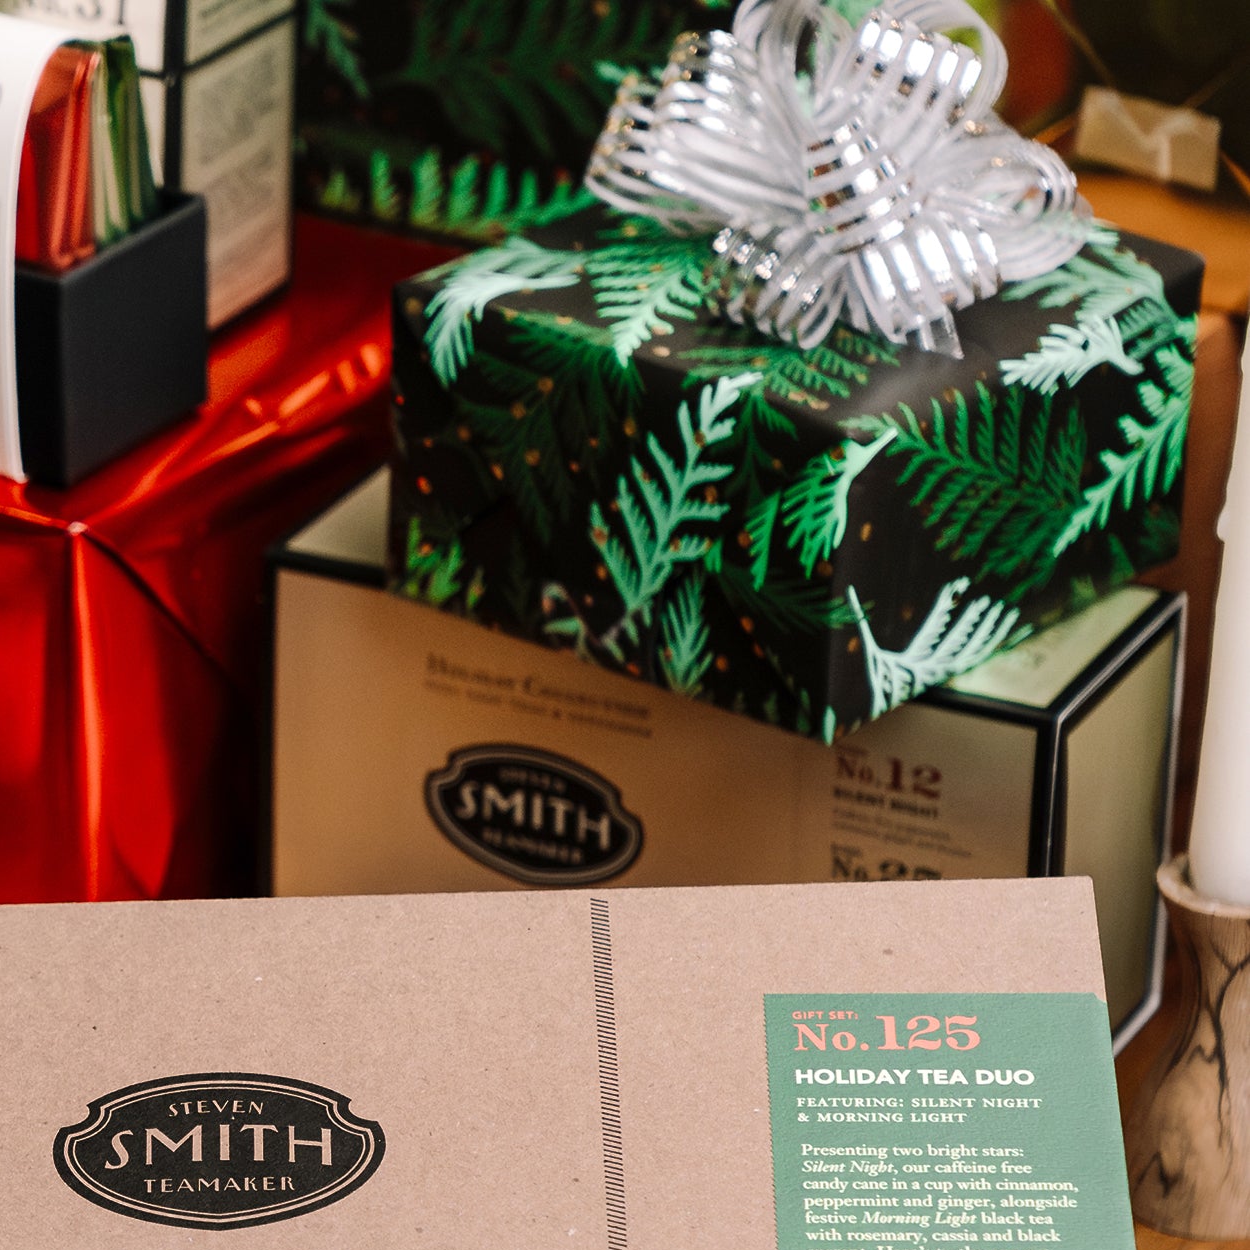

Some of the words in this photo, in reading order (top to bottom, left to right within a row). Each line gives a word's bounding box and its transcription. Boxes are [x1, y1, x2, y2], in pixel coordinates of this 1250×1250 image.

[886, 757, 942, 798] 12
[455, 781, 610, 850] SMITH
[792, 1011, 824, 1020] GIFT
[828, 1011, 859, 1020] SET:
[793, 1023, 870, 1051] No.
[876, 1015, 981, 1051] 125
[795, 1069, 911, 1085] HOLIDAY
[917, 1069, 969, 1085] TEA
[975, 1069, 1036, 1086] DUO
[168, 1100, 264, 1117] STEVEN
[797, 1097, 904, 1108] FEATURING:
[911, 1097, 976, 1108] SILENT
[982, 1097, 1043, 1109] NIGHT
[797, 1113, 810, 1123] &
[817, 1112, 903, 1123] MORNING
[910, 1112, 968, 1123] LIGHT
[104, 1124, 333, 1170] SMITH
[801, 1143, 888, 1160] Presenting
[893, 1146, 923, 1157] two
[927, 1144, 978, 1160] bright
[982, 1146, 1024, 1157] stars:
[802, 1160, 846, 1173] Silent
[849, 1160, 899, 1177] Night,
[902, 1164, 931, 1173] our
[934, 1161, 997, 1174] caffeine
[1001, 1161, 1033, 1174] free
[143, 1176, 295, 1194] TEAMAKER
[802, 1177, 849, 1193] candy
[852, 1180, 888, 1190] cane
[892, 1178, 908, 1190] in
[911, 1181, 920, 1190] a
[924, 1181, 953, 1193] cup
[956, 1178, 992, 1191] with
[995, 1178, 1079, 1193] cinnamon,
[804, 1195, 899, 1210] peppermint
[903, 1194, 933, 1207] and
[937, 1195, 996, 1211] ginger,
[1000, 1195, 1078, 1211] alongside
[805, 1210, 857, 1224] festive
[862, 1211, 931, 1228] Morning
[935, 1211, 977, 1228] Light
[981, 1212, 1025, 1225] black
[1029, 1215, 1054, 1225] tea
[805, 1228, 842, 1241] with
[847, 1231, 928, 1245] rosemary,
[932, 1229, 978, 1242] cassia
[982, 1229, 1013, 1242] and
[1017, 1229, 1062, 1242] black
